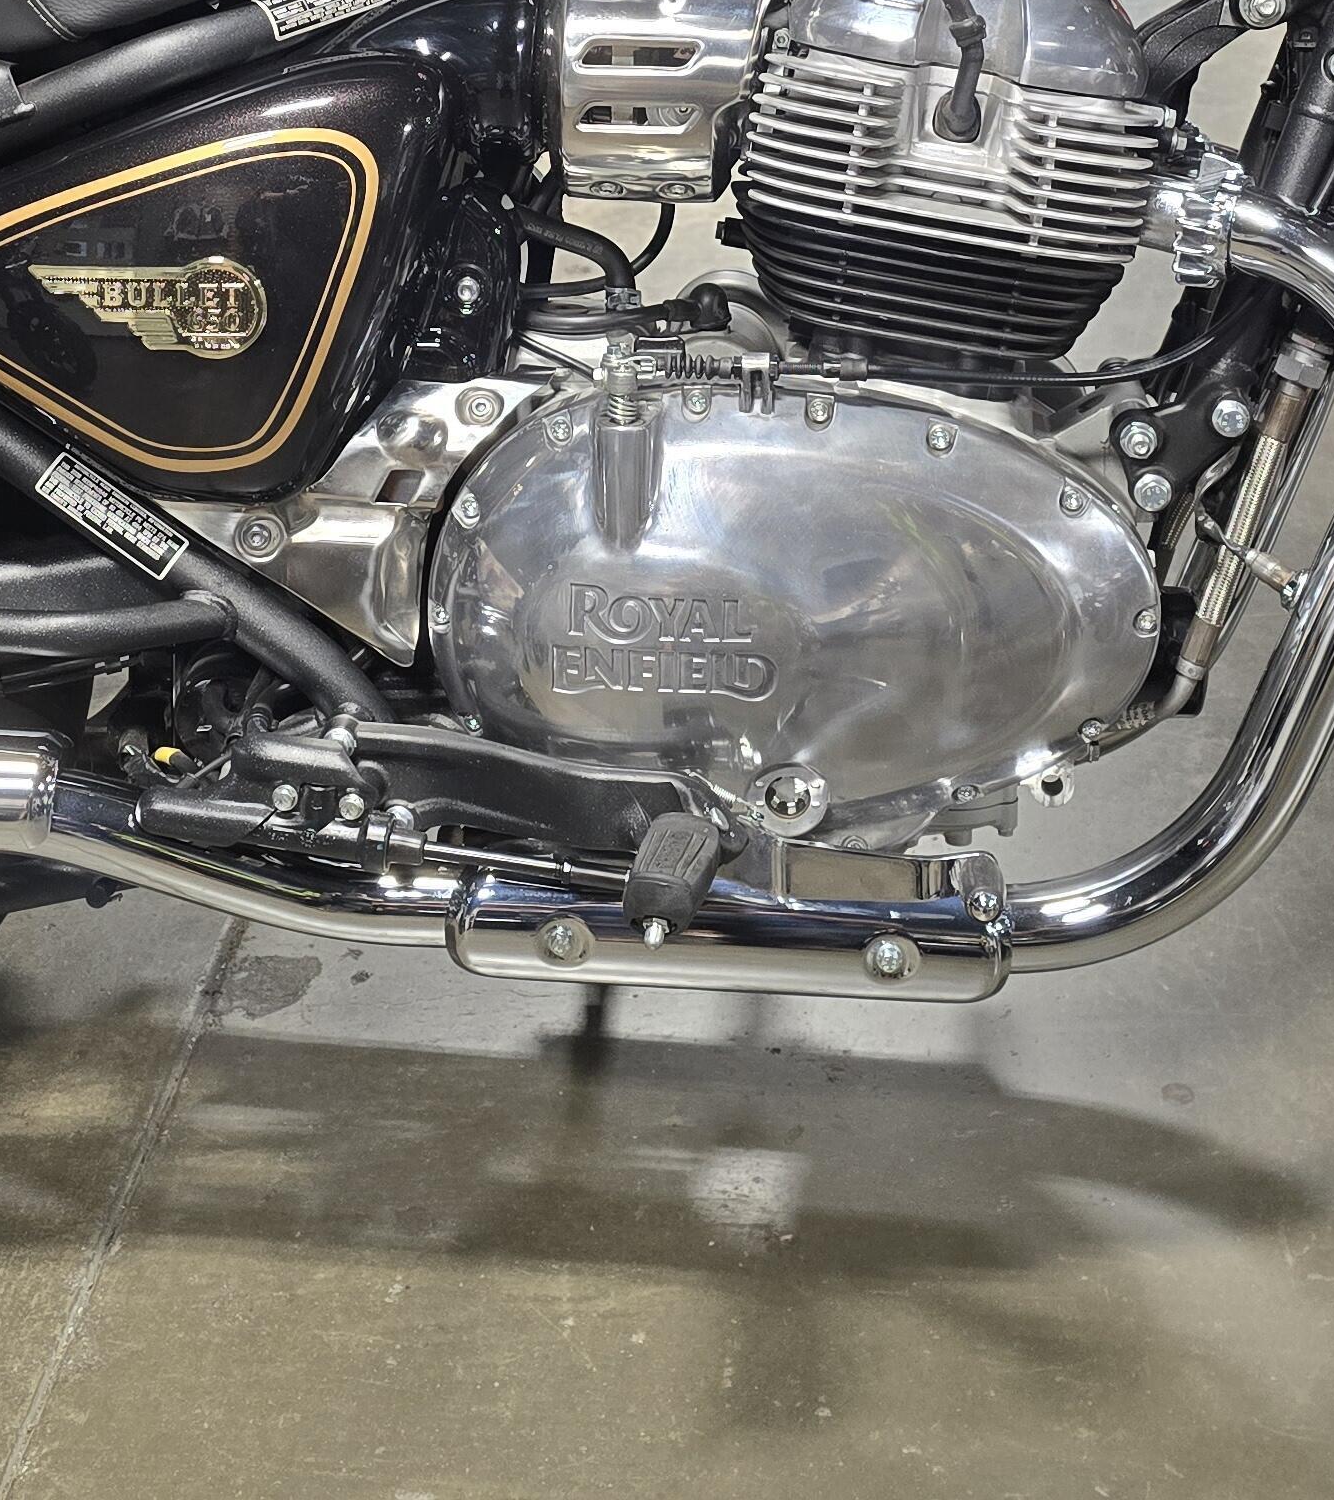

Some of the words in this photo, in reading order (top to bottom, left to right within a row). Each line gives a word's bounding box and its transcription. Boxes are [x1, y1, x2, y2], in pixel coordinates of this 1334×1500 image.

[102, 282, 245, 308] BULLET
[187, 309, 241, 332] 650
[568, 583, 756, 644] ROYAL
[552, 644, 780, 703] ENFIELD
